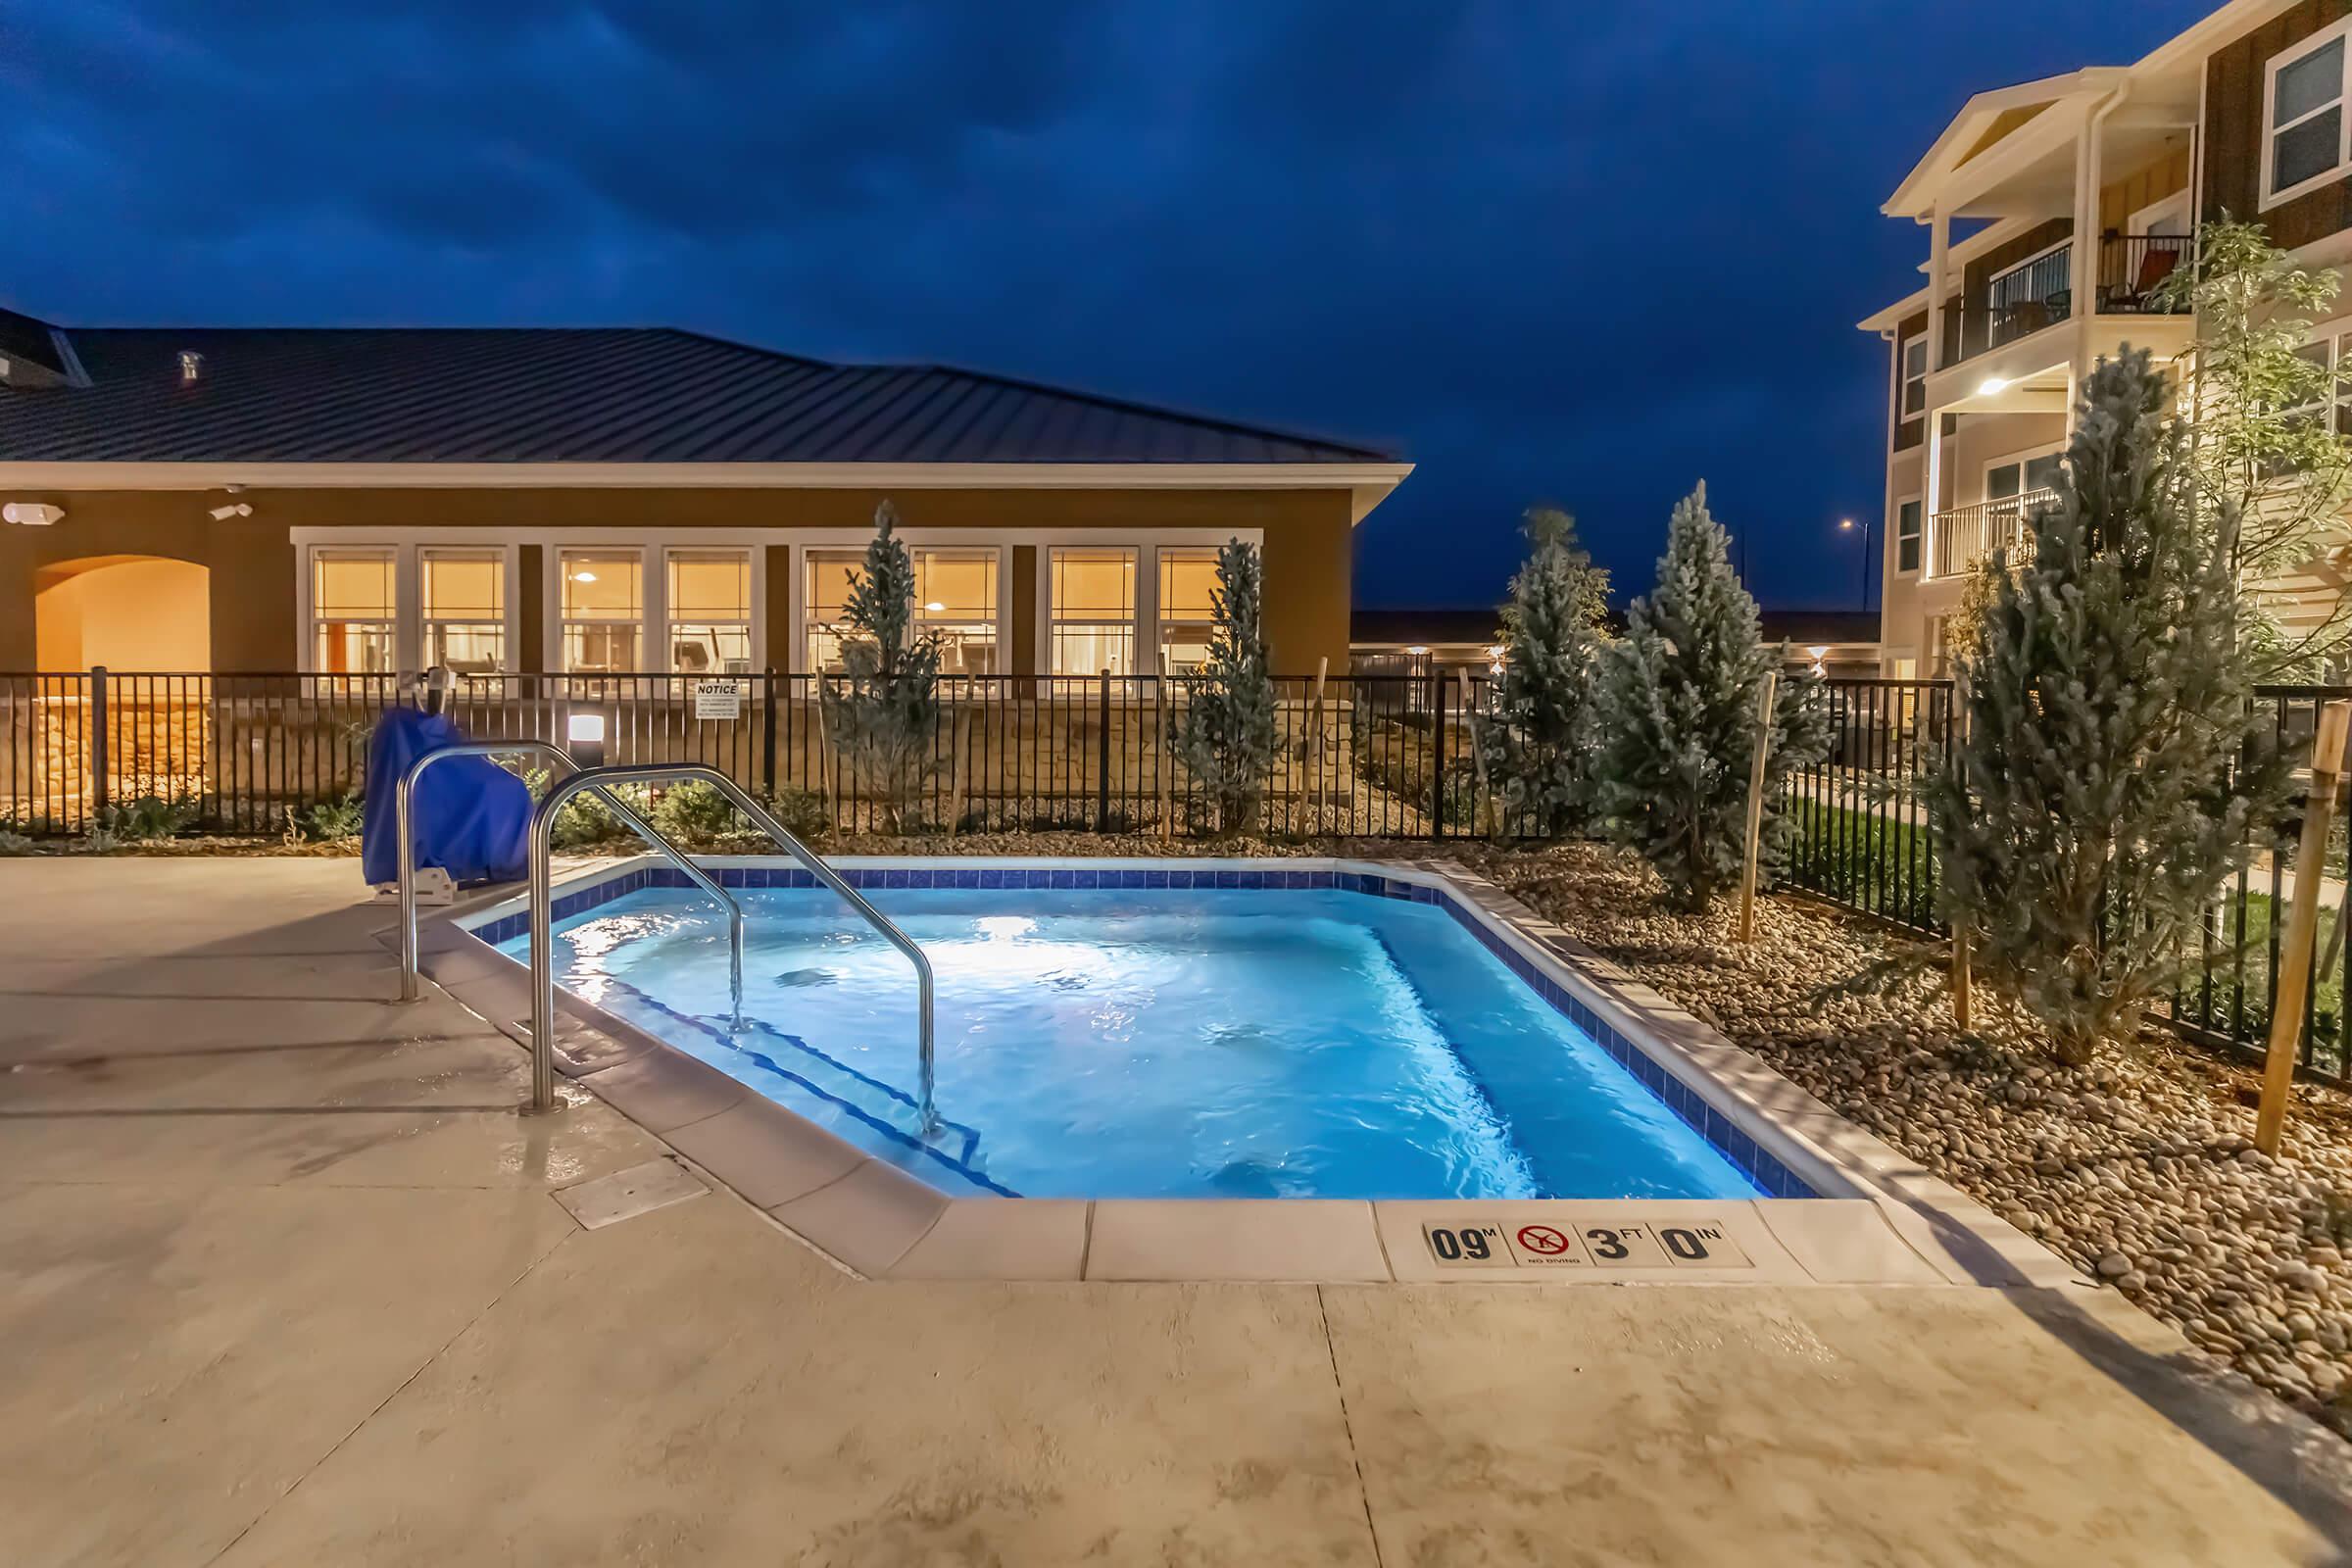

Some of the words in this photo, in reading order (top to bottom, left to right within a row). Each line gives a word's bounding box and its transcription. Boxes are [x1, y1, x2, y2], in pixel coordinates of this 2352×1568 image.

[698, 685, 737, 694] NOTICE
[1587, 1229, 1629, 1259] 3
[1620, 1228, 1642, 1240] FT
[1660, 1229, 1709, 1259] 0
[1695, 1229, 1722, 1240] IN
